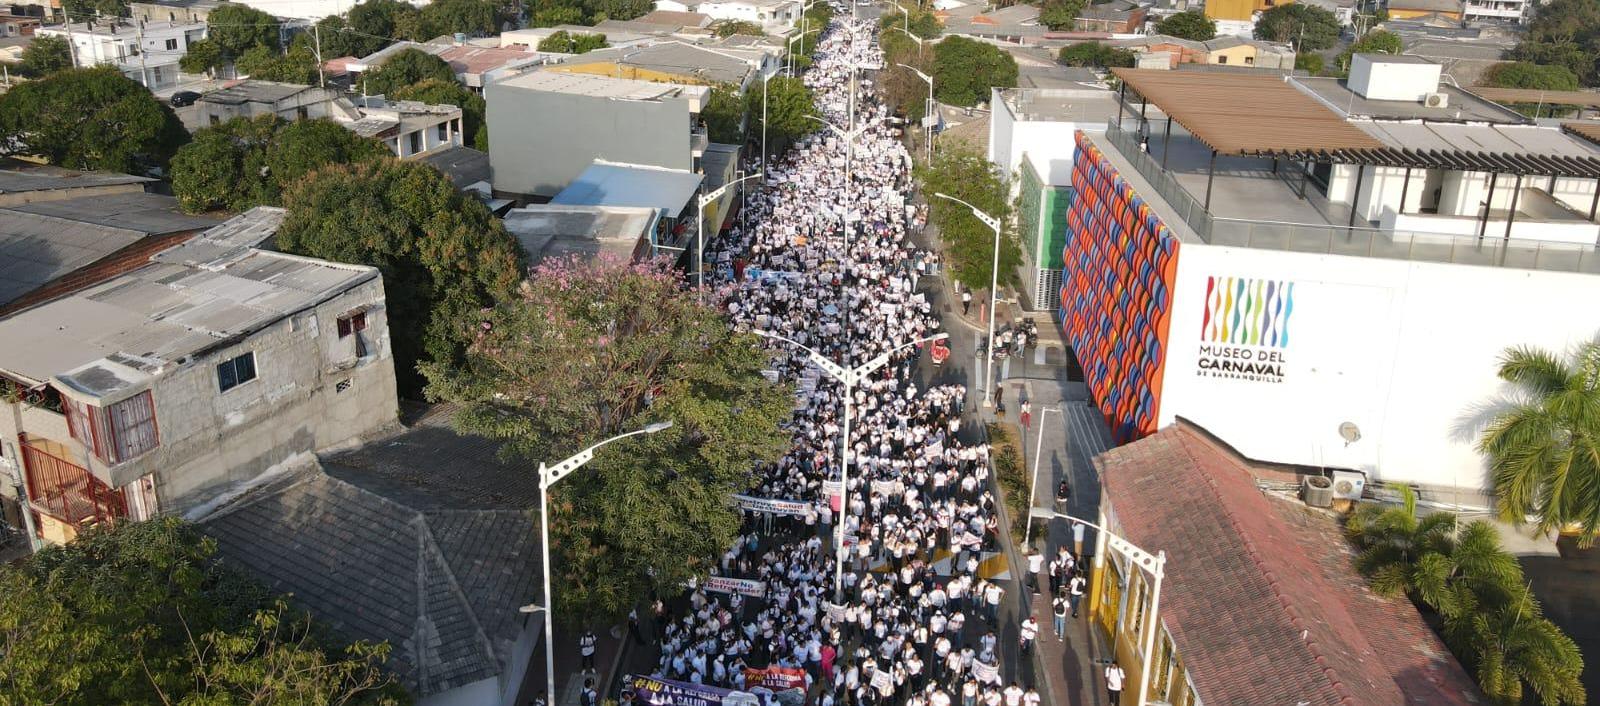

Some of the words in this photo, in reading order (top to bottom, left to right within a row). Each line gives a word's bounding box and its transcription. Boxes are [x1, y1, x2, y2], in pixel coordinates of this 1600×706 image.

[1199, 345, 1252, 359] MUSEO
[1258, 350, 1285, 363] DEL
[1198, 357, 1284, 377] CARNAVAL
[1212, 371, 1282, 383] BARRANQUILLA
[707, 582, 760, 594] Retroeder
[664, 685, 670, 693] A
[672, 687, 682, 695] LA
[676, 696, 707, 706] SALUD
